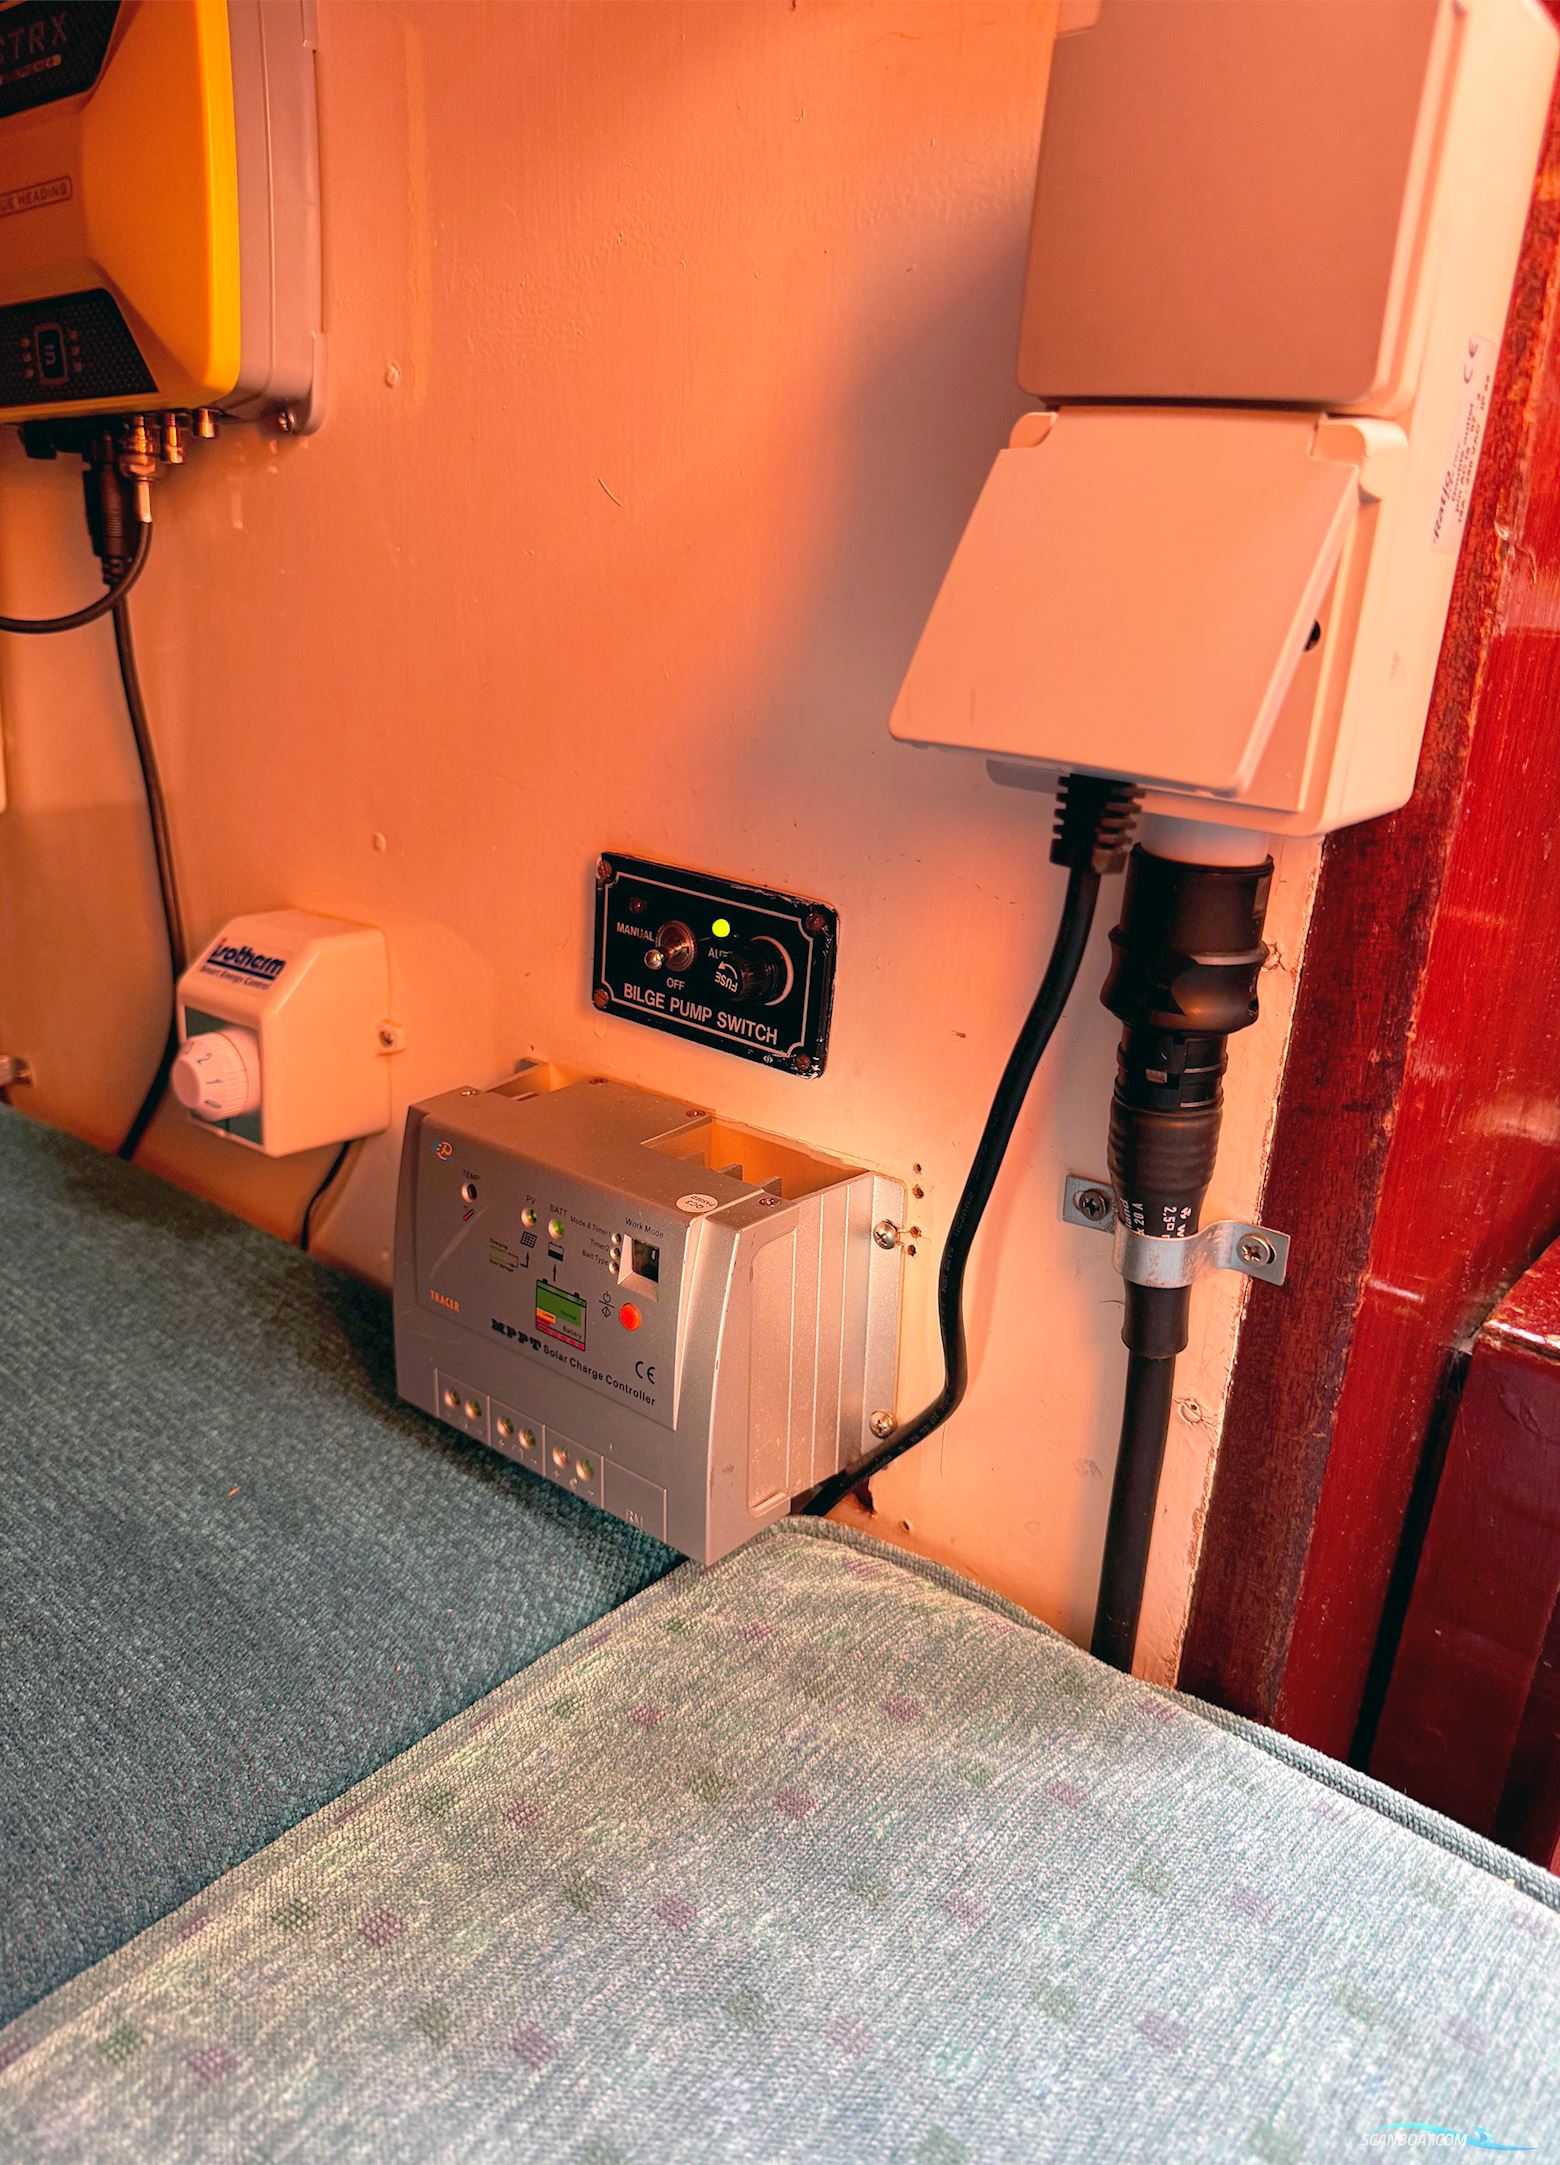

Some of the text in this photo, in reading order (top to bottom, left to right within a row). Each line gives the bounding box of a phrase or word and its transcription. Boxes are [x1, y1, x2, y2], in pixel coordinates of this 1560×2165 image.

[0, 11, 67, 64] TRX
[616, 922, 655, 942] MANUAL
[667, 977, 685, 991] OFF
[715, 972, 738, 993] FUSE
[623, 983, 778, 1045] BILGE PUMP SWITCH
[525, 1195, 537, 1205] PV
[549, 1204, 567, 1217] BATT
[625, 1217, 665, 1239] Work Mode
[491, 1318, 657, 1406] MPPT Solar Charge Controller
